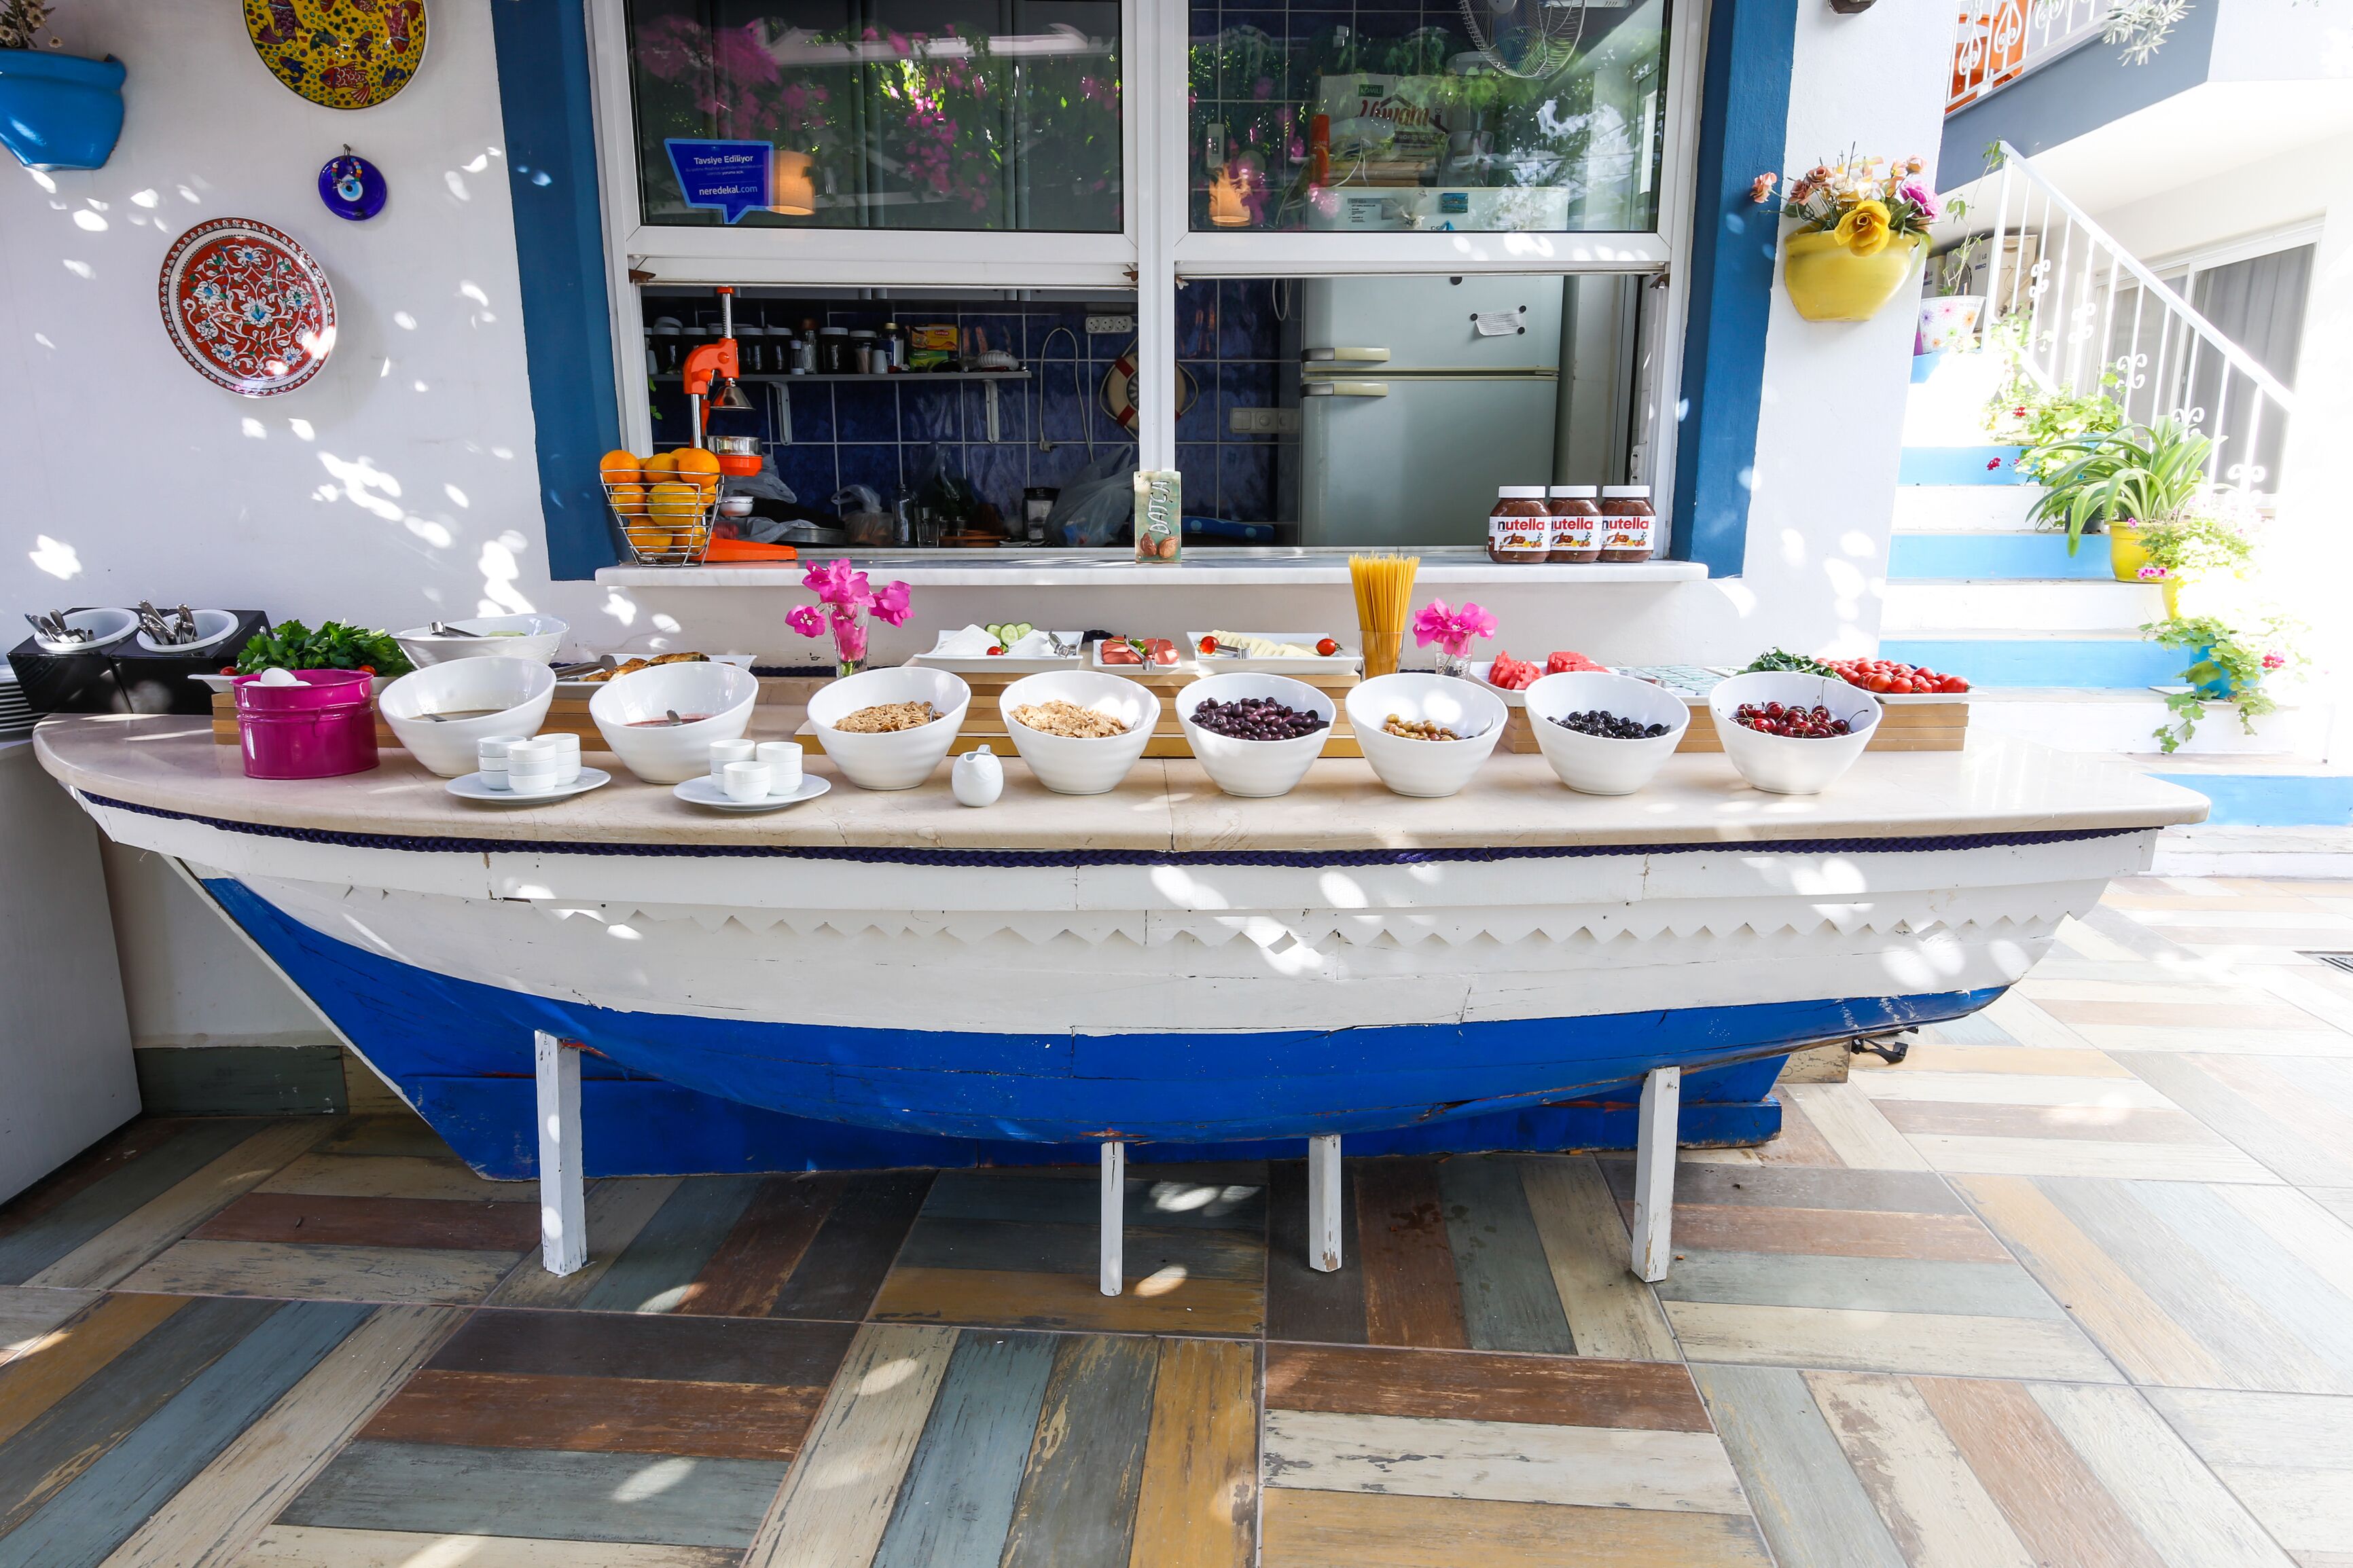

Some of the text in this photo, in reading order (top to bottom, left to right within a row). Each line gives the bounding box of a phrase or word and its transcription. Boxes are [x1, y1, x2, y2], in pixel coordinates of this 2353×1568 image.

[694, 155, 753, 164] Tavsiye Ediliyor
[699, 185, 758, 196] neredekal.com
[1148, 480, 1173, 535] DATÇA
[1498, 518, 1545, 530] nutella
[1602, 517, 1649, 530] nutella
